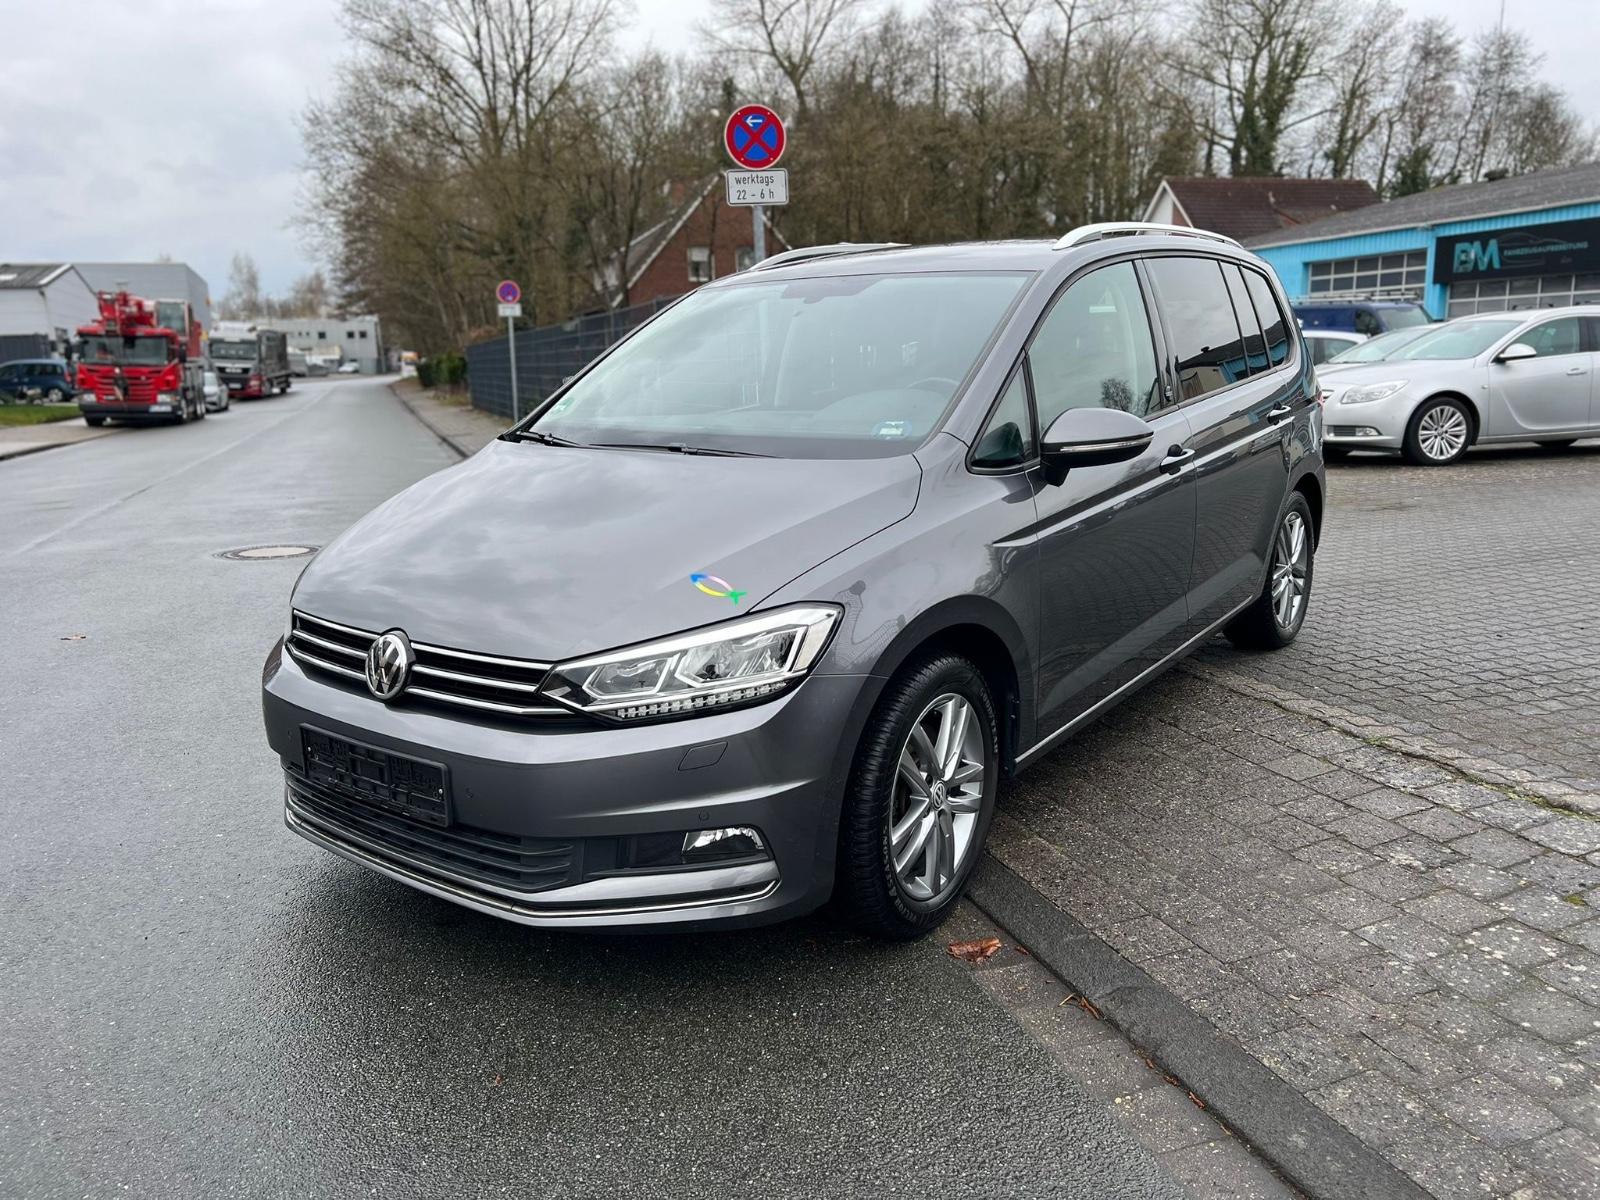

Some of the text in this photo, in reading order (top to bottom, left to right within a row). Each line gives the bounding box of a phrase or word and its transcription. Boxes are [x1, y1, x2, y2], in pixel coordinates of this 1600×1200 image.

[734, 174, 774, 186] werktags
[737, 189, 747, 200] 22
[760, 188, 765, 199] 6
[769, 188, 774, 199] h
